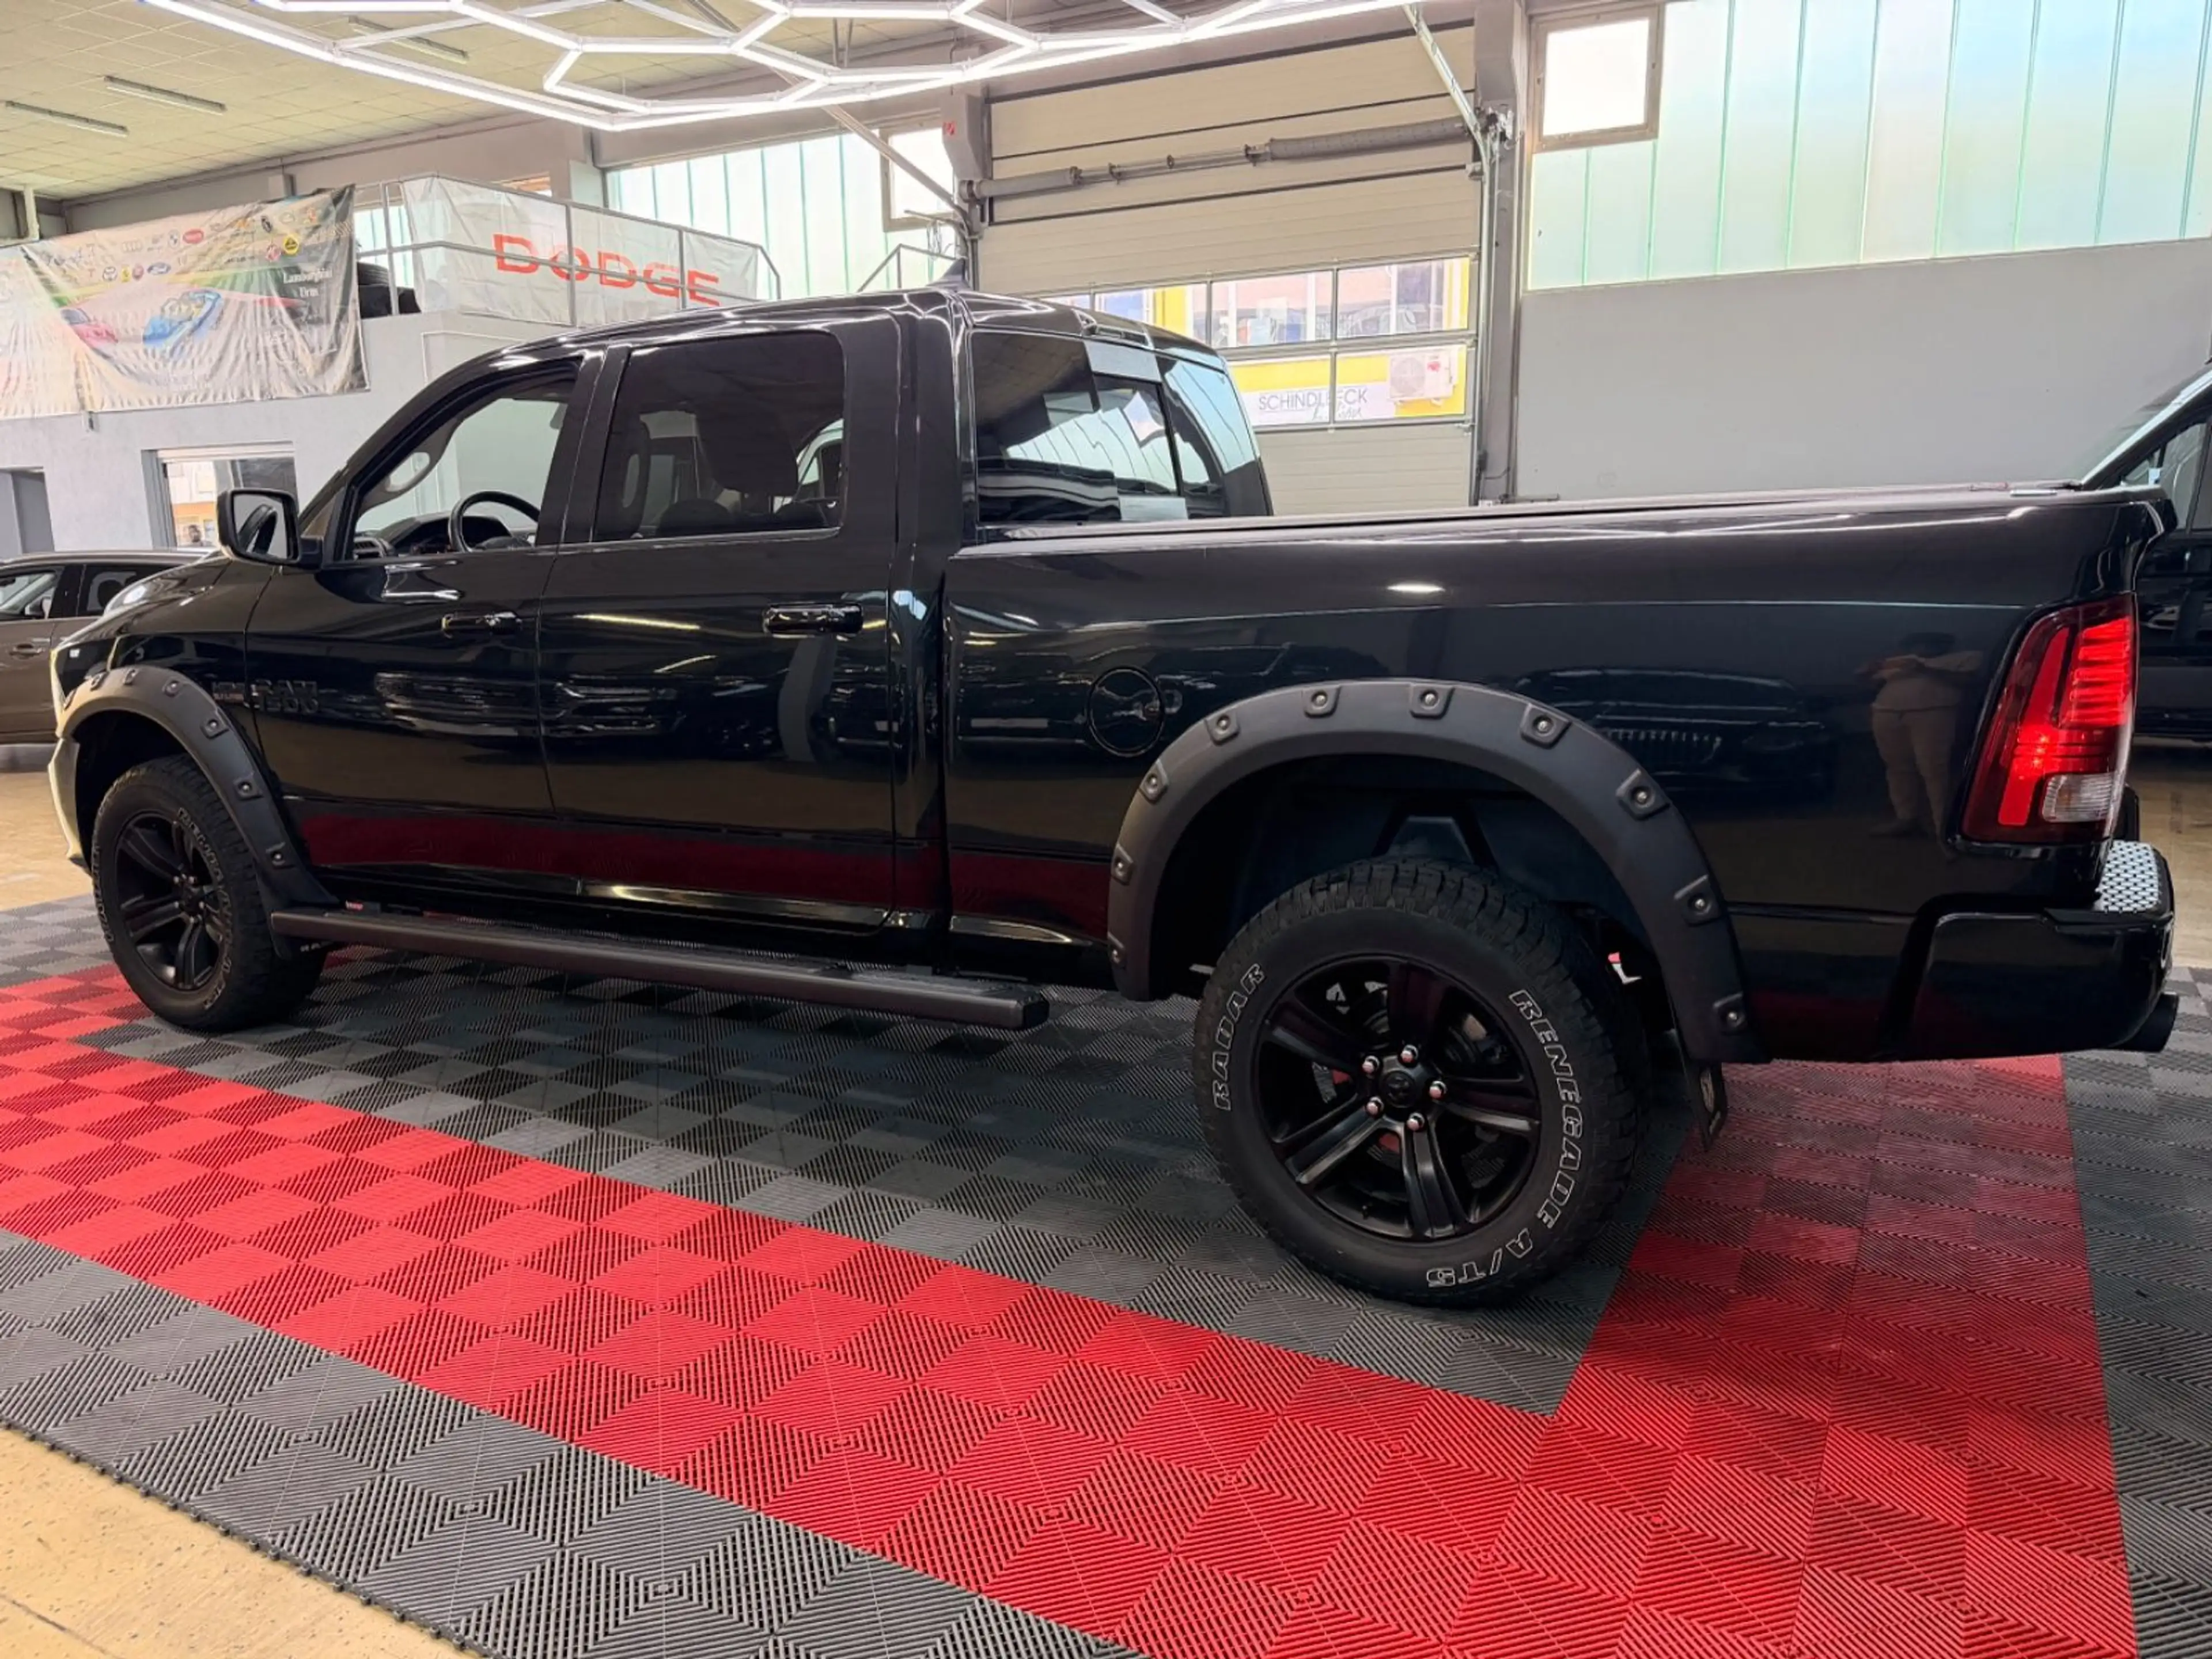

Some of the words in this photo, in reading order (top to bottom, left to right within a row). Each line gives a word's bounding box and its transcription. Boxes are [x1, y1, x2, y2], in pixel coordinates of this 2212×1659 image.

[493, 232, 721, 306] DODGE
[1211, 963, 1267, 1111] RADAR
[1507, 988, 1584, 1230] RENEGADE
